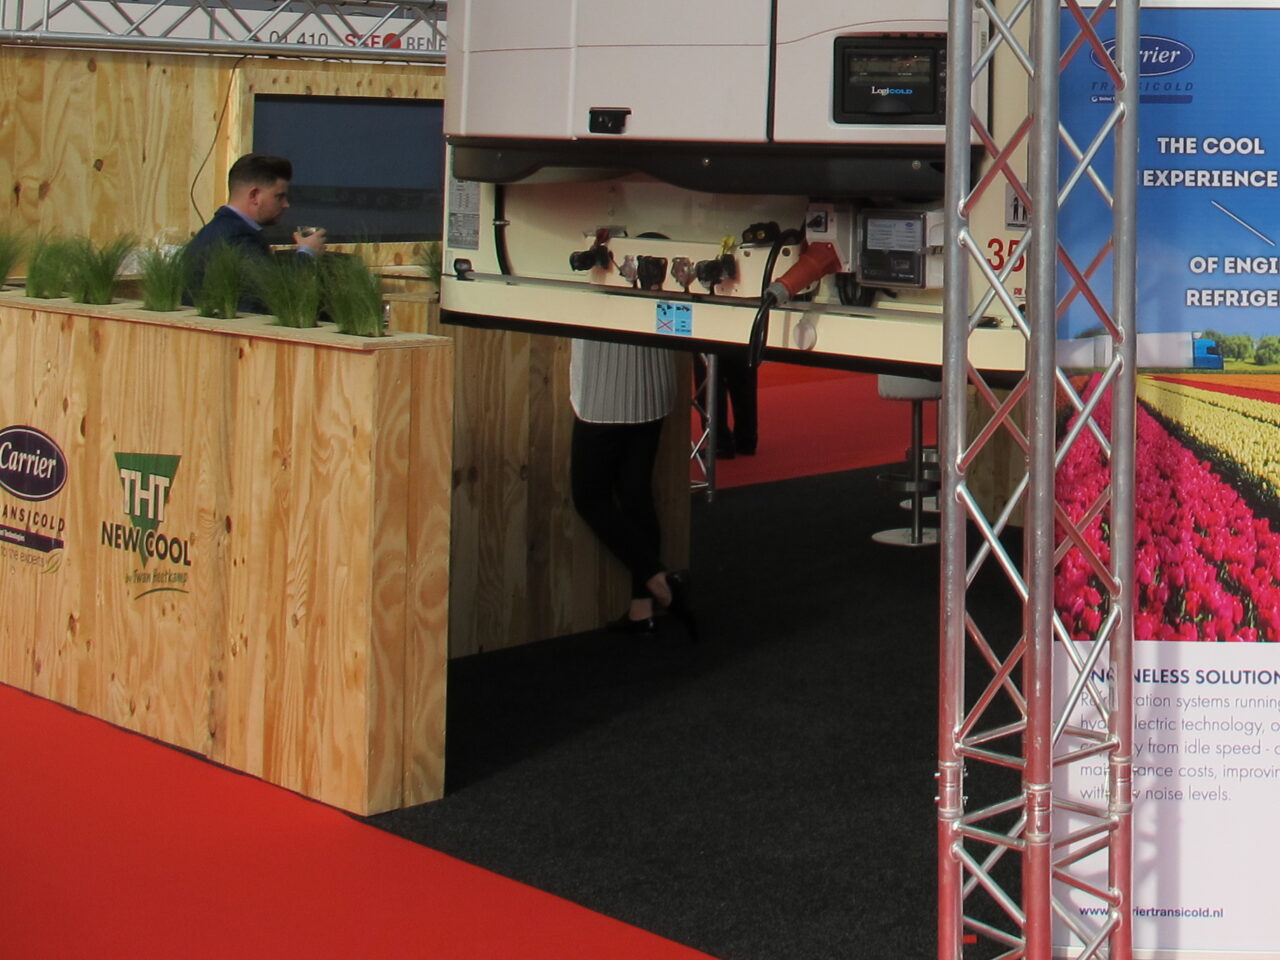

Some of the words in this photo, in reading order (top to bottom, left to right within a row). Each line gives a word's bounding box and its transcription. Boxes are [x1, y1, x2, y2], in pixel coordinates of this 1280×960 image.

[1091, 81, 1194, 92] TRICOLD
[1157, 137, 1197, 155] THE
[1202, 137, 1265, 155] COOL
[1142, 169, 1279, 188] EXPERIENCE
[1189, 256, 1218, 275] OF
[0, 441, 57, 479] Carrier
[120, 468, 170, 522] THT
[102, 521, 140, 552] NEW
[144, 531, 192, 566] COOL
[1086, 669, 1190, 684] NNELESS
[1081, 691, 1171, 707] Rration
[1176, 695, 1231, 711] systems
[1081, 714, 1177, 732] hylectric
[1181, 716, 1265, 736] technology,
[1148, 737, 1179, 755] from
[1184, 738, 1211, 755] idle
[1215, 739, 1261, 757] speed
[1080, 763, 1174, 778] maiance
[1178, 766, 1217, 779] costs,
[1145, 788, 1184, 801] noise
[1188, 785, 1232, 801] levels.
[1079, 906, 1224, 919] wwwriertransicold.nl
